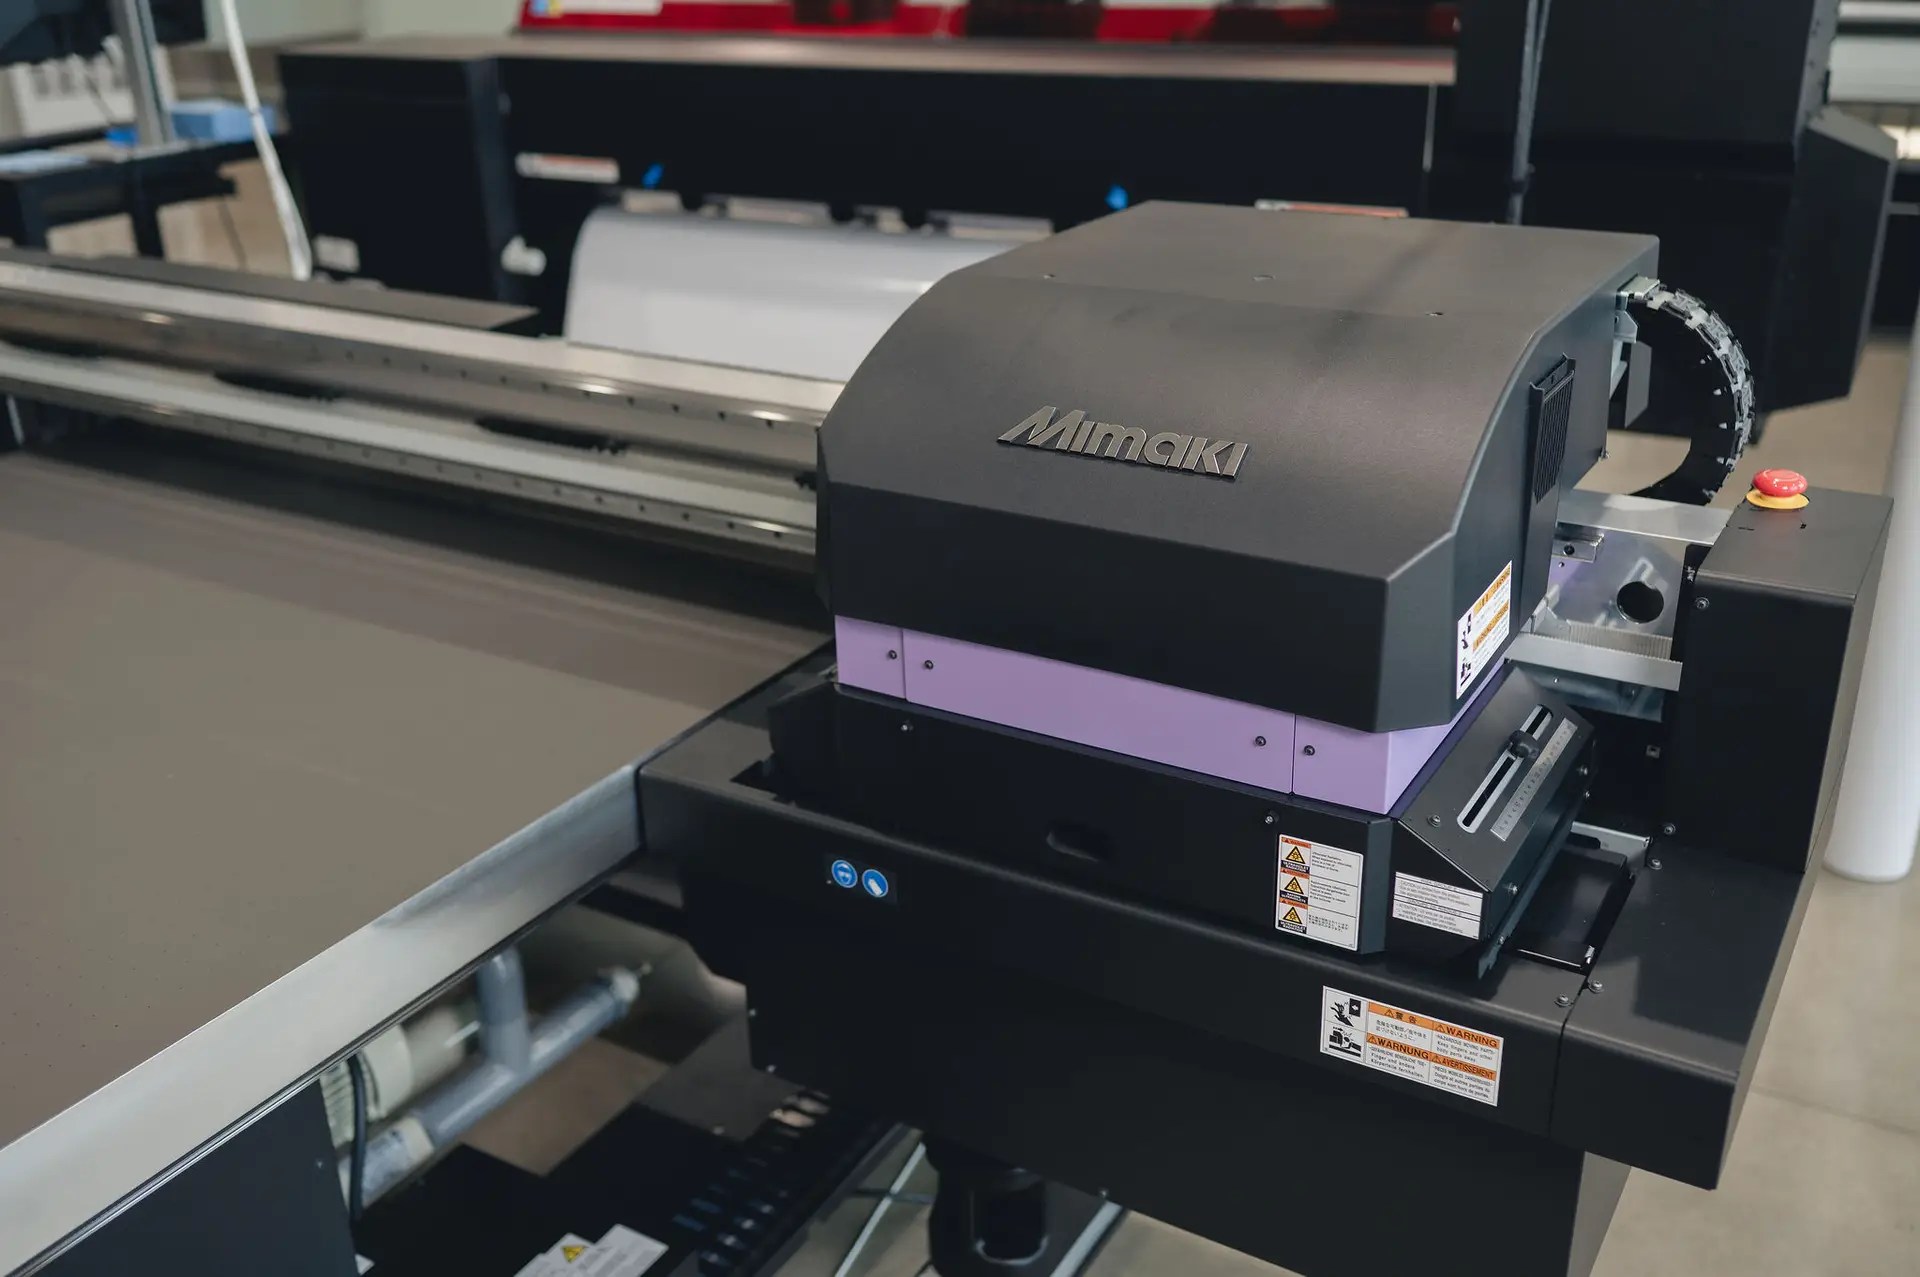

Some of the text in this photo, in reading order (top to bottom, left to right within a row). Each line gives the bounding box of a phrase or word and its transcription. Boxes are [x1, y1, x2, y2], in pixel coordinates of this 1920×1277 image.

[1447, 1027, 1497, 1048] WARNING
[1378, 1038, 1429, 1060] WARNUNG
[1442, 1058, 1493, 1079] AVERTISSEMENT
